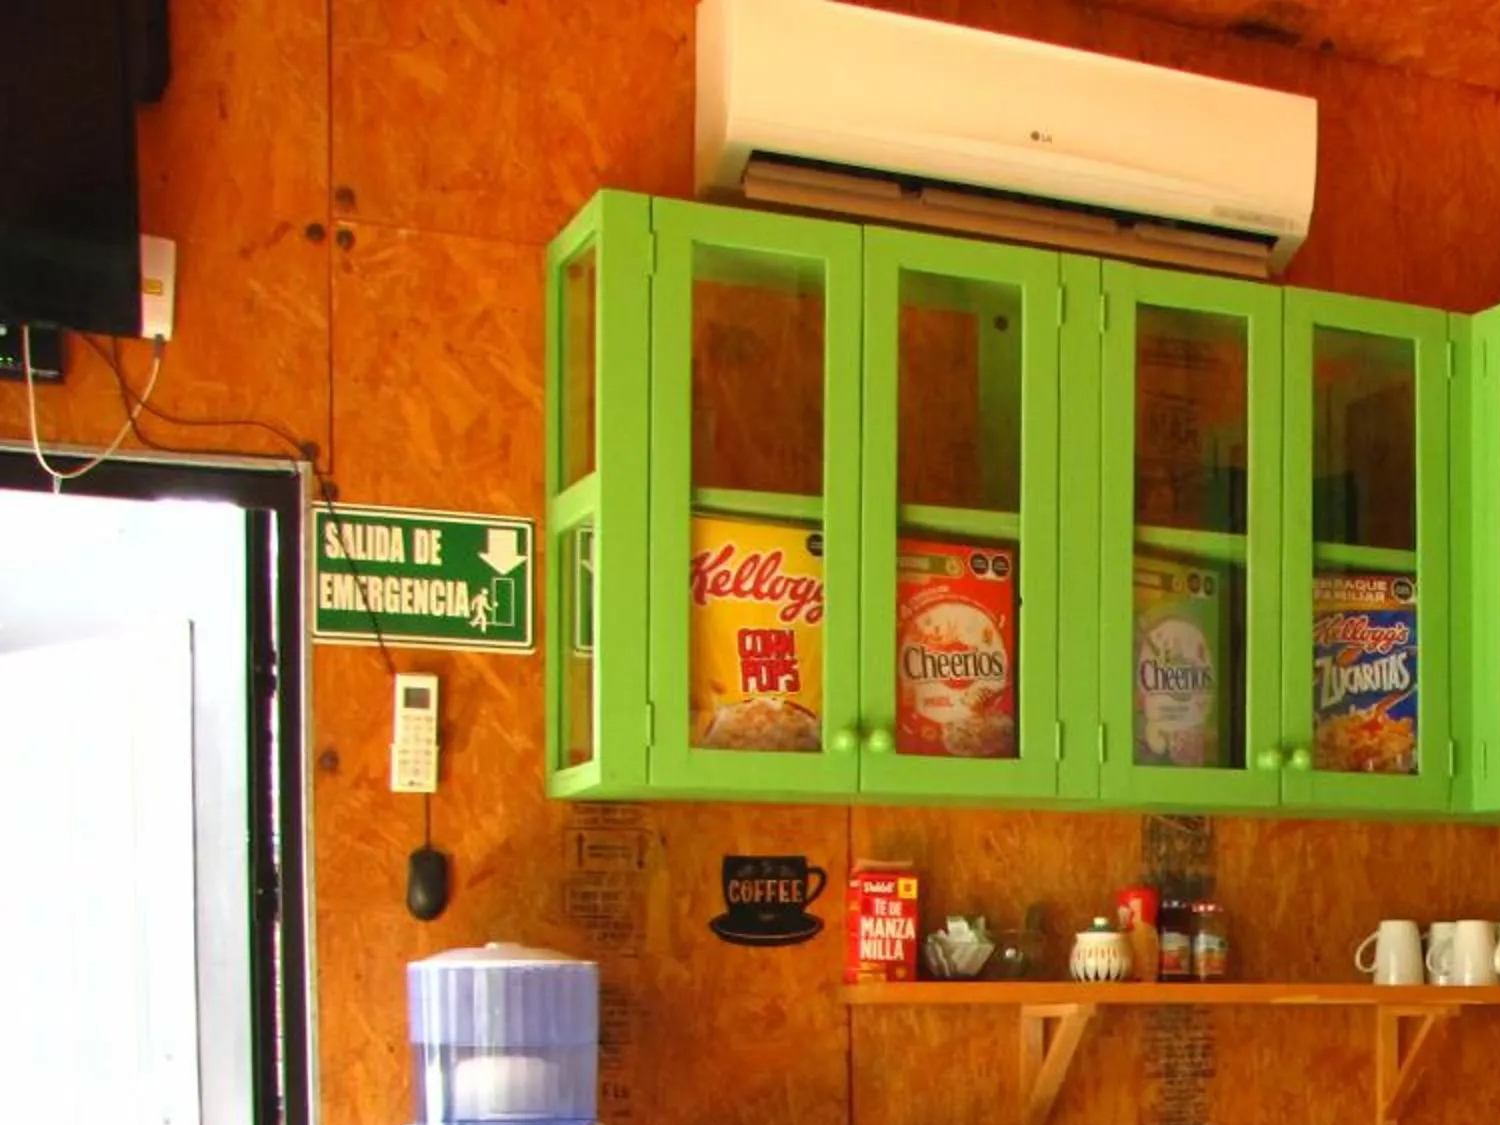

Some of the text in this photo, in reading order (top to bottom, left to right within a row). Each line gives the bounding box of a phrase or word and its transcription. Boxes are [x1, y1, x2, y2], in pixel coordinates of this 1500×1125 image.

[325, 521, 442, 566] SALIDA DE
[319, 572, 471, 618] EMERGENCIA
[903, 645, 1005, 680] Cheerios
[1140, 658, 1214, 692] Cheerios
[728, 879, 804, 904] COFFEE
[889, 899, 903, 917] DE
[860, 916, 916, 940] MANZA
[860, 938, 905, 961] NILLA
